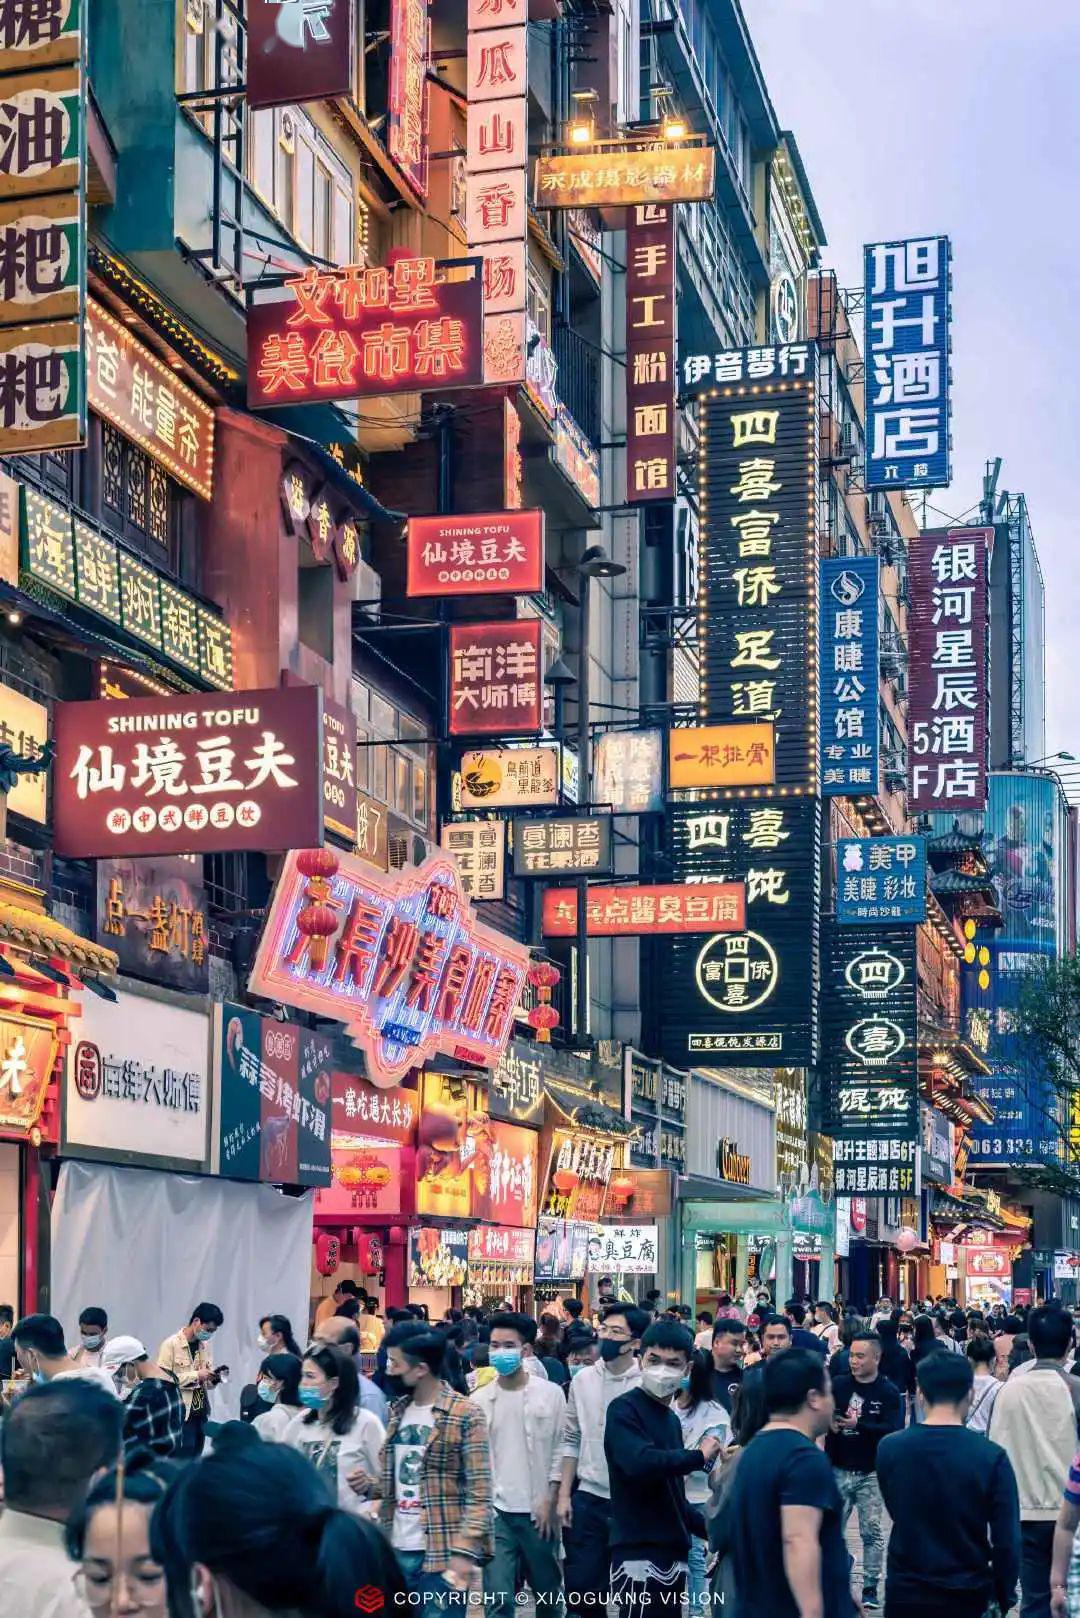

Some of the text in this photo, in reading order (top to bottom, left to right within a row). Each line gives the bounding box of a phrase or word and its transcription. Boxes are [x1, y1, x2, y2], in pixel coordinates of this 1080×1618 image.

[475, 0, 518, 299] 瓜山香肠
[257, 317, 465, 393] 美食市集
[872, 240, 940, 459] 旭升酒店
[684, 346, 808, 384] 伊音琴行
[132, 362, 200, 467] 能量茶
[440, 525, 510, 537] SHINING TOFU
[421, 536, 527, 567] 仙境豆夫
[730, 409, 783, 719] 四喜富侨足道
[454, 642, 536, 682] 南洋
[931, 544, 978, 798] 银河星辰酒店
[454, 683, 536, 710] 大师傅
[108, 707, 260, 733] SHINING TOFU
[70, 732, 298, 799] 仙境豆夫
[324, 735, 354, 787] 豆夫
[675, 743, 769, 768] 一根排骨
[824, 744, 872, 760] 专业
[108, 802, 259, 832] 新中式鲜豆饮
[686, 808, 790, 849] 四喜
[869, 844, 916, 871] 美甲
[883, 874, 916, 901] 彩妆
[725, 936, 749, 955] 四
[702, 960, 771, 981] 富 侨
[860, 962, 892, 983] 四
[722, 984, 748, 1005] 喜
[691, 1035, 779, 1049] 四喜馄饨发源店
[858, 1027, 894, 1053] 喜
[838, 1088, 909, 1112] 馄饨
[601, 1239, 655, 1263] 臭豆腐
